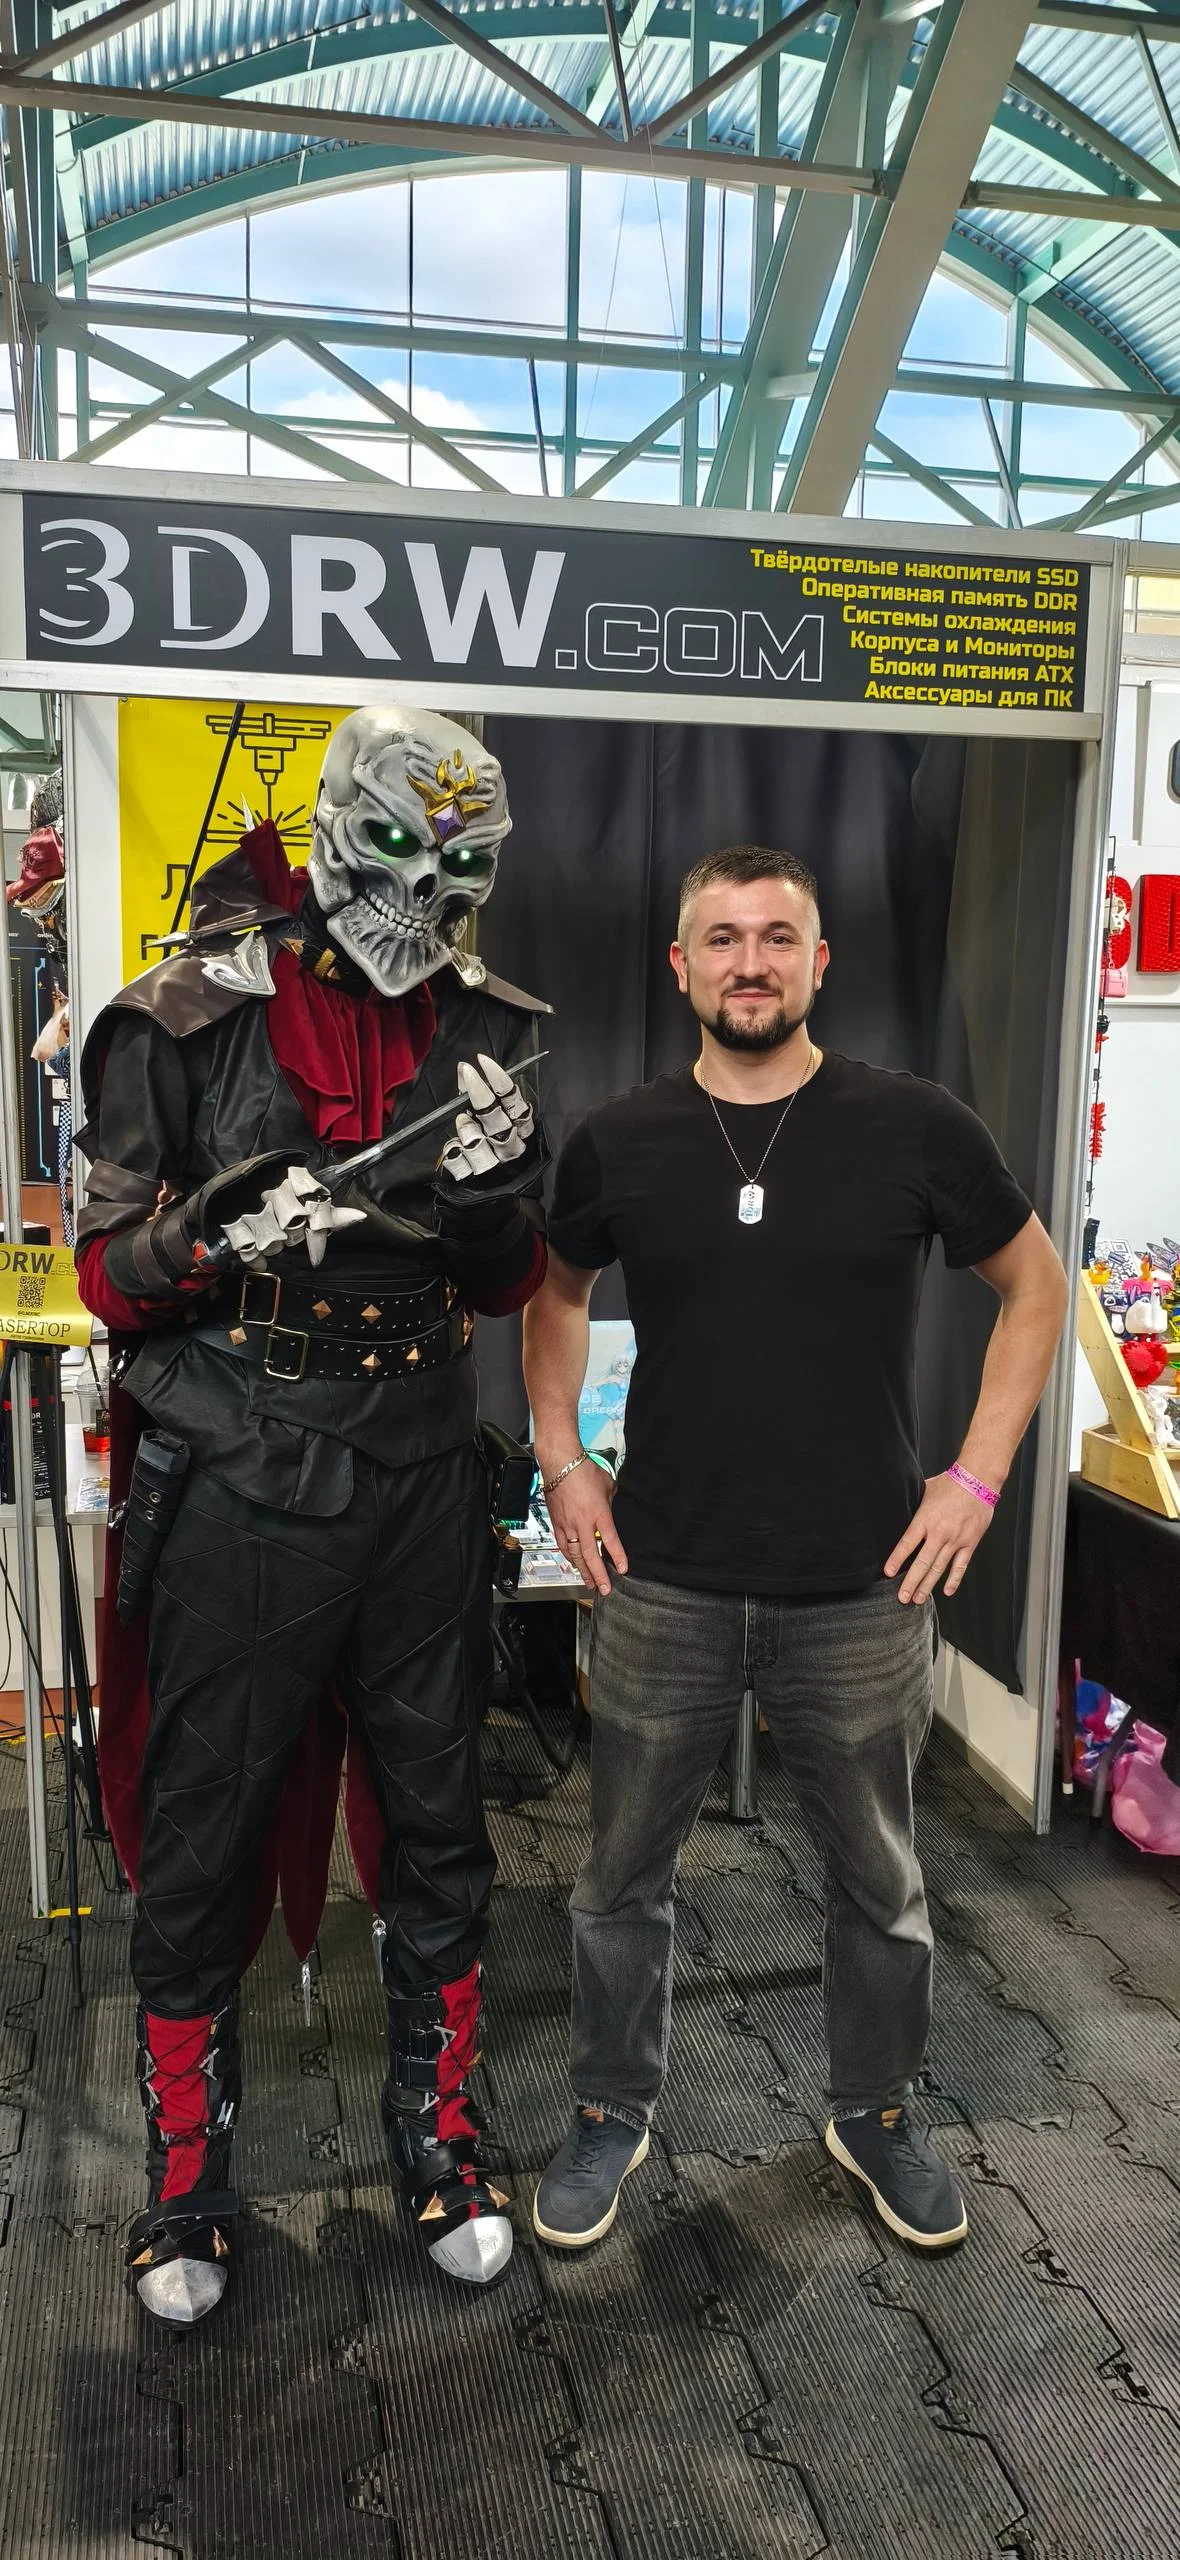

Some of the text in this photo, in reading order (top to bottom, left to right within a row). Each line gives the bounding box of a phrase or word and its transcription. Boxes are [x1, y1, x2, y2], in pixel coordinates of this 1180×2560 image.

[750, 548, 1078, 588] Твёрдотелые накопители SSD
[801, 576, 1078, 611] Оперативная память DDR
[842, 604, 1076, 636] Системы охлаждения
[850, 630, 1075, 663] Корпуса и Мониторы
[869, 656, 1073, 684] Блоки питания ATX
[864, 680, 1073, 709] Аксессуары для ПК
